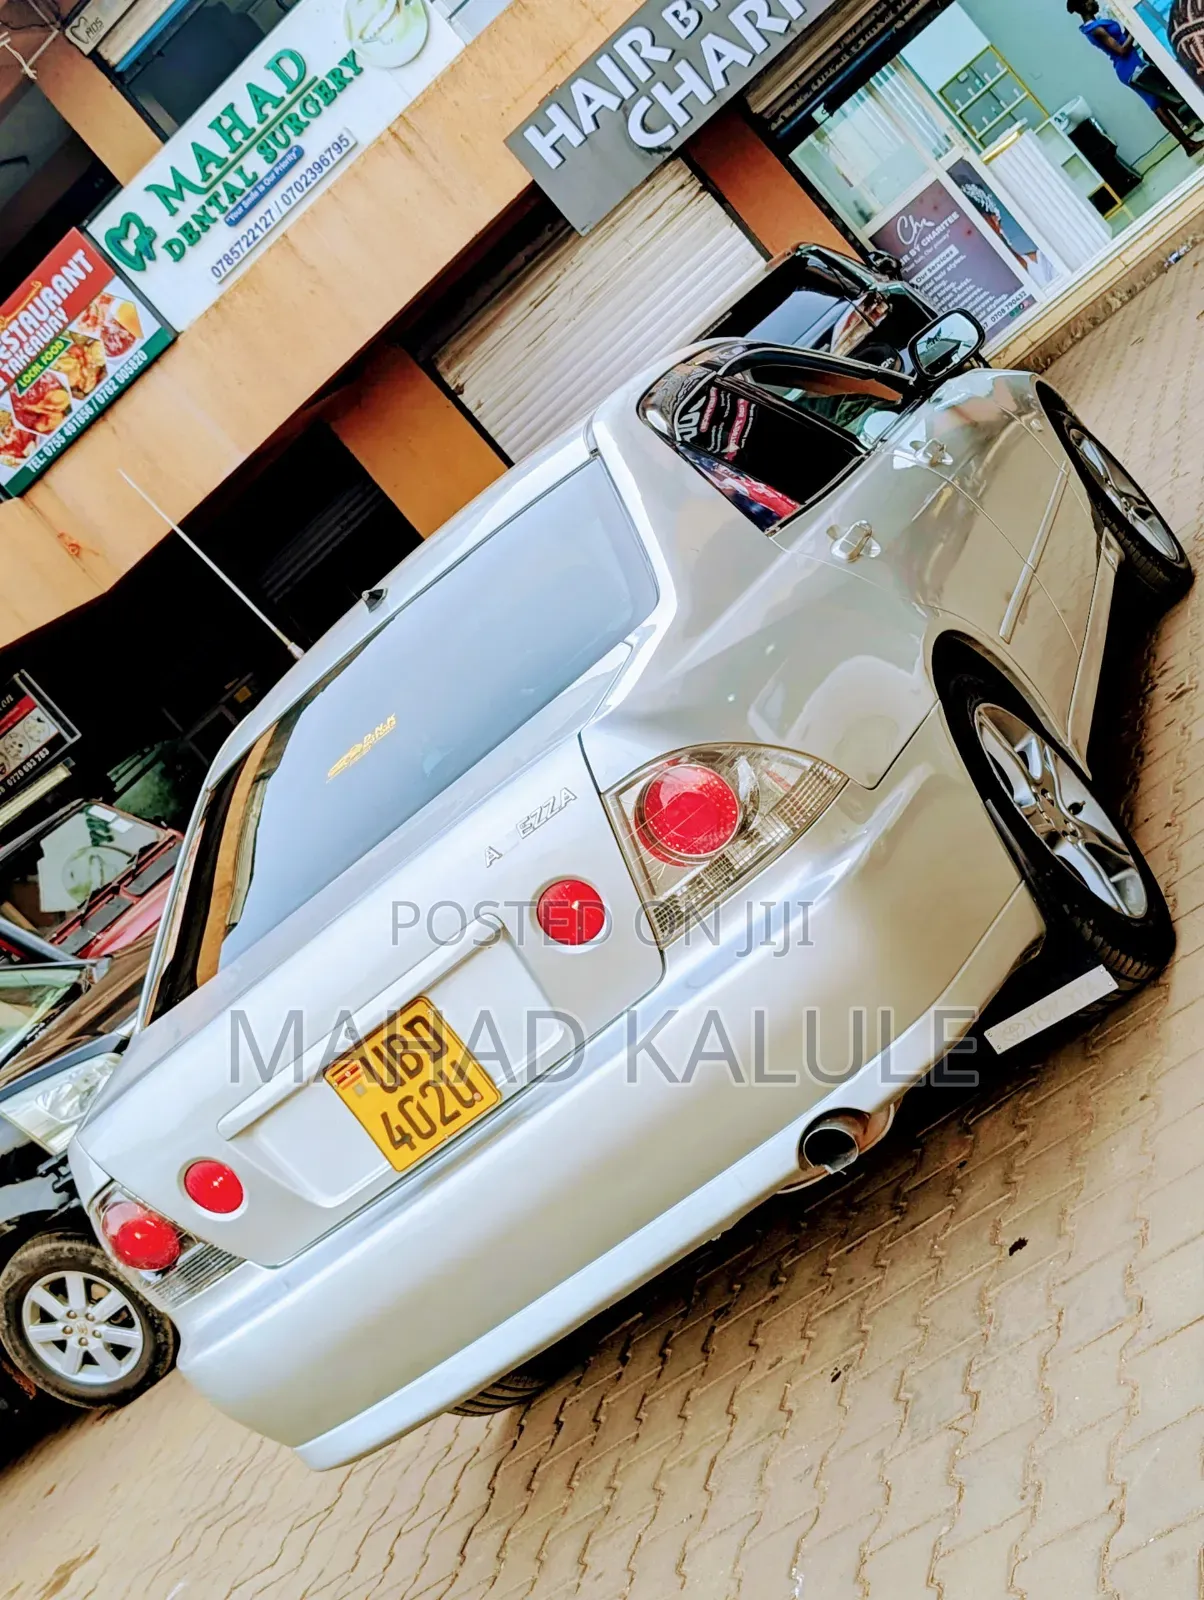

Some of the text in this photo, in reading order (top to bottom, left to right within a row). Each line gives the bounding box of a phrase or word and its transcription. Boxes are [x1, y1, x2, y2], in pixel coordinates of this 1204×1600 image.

[144, 48, 308, 217] MAHAD
[523, 25, 675, 170] HAIR
[161, 48, 364, 263] DENTAL SURGERY
[210, 208, 277, 279] 0785722127
[280, 134, 351, 206] 0702396795
[920, 211, 960, 247] CHARITEE
[0, 248, 94, 362] ESTAURANT
[915, 249, 954, 284] Our Services
[3, 307, 70, 379] TAKEAWAY
[990, 308, 1007, 323] 0708
[18, 340, 65, 387] LOCAL FOOD
[25, 452, 48, 474] TEL:
[45, 436, 67, 457] 0755
[99, 381, 120, 405] 0782
[358, 1015, 449, 1093] UBD
